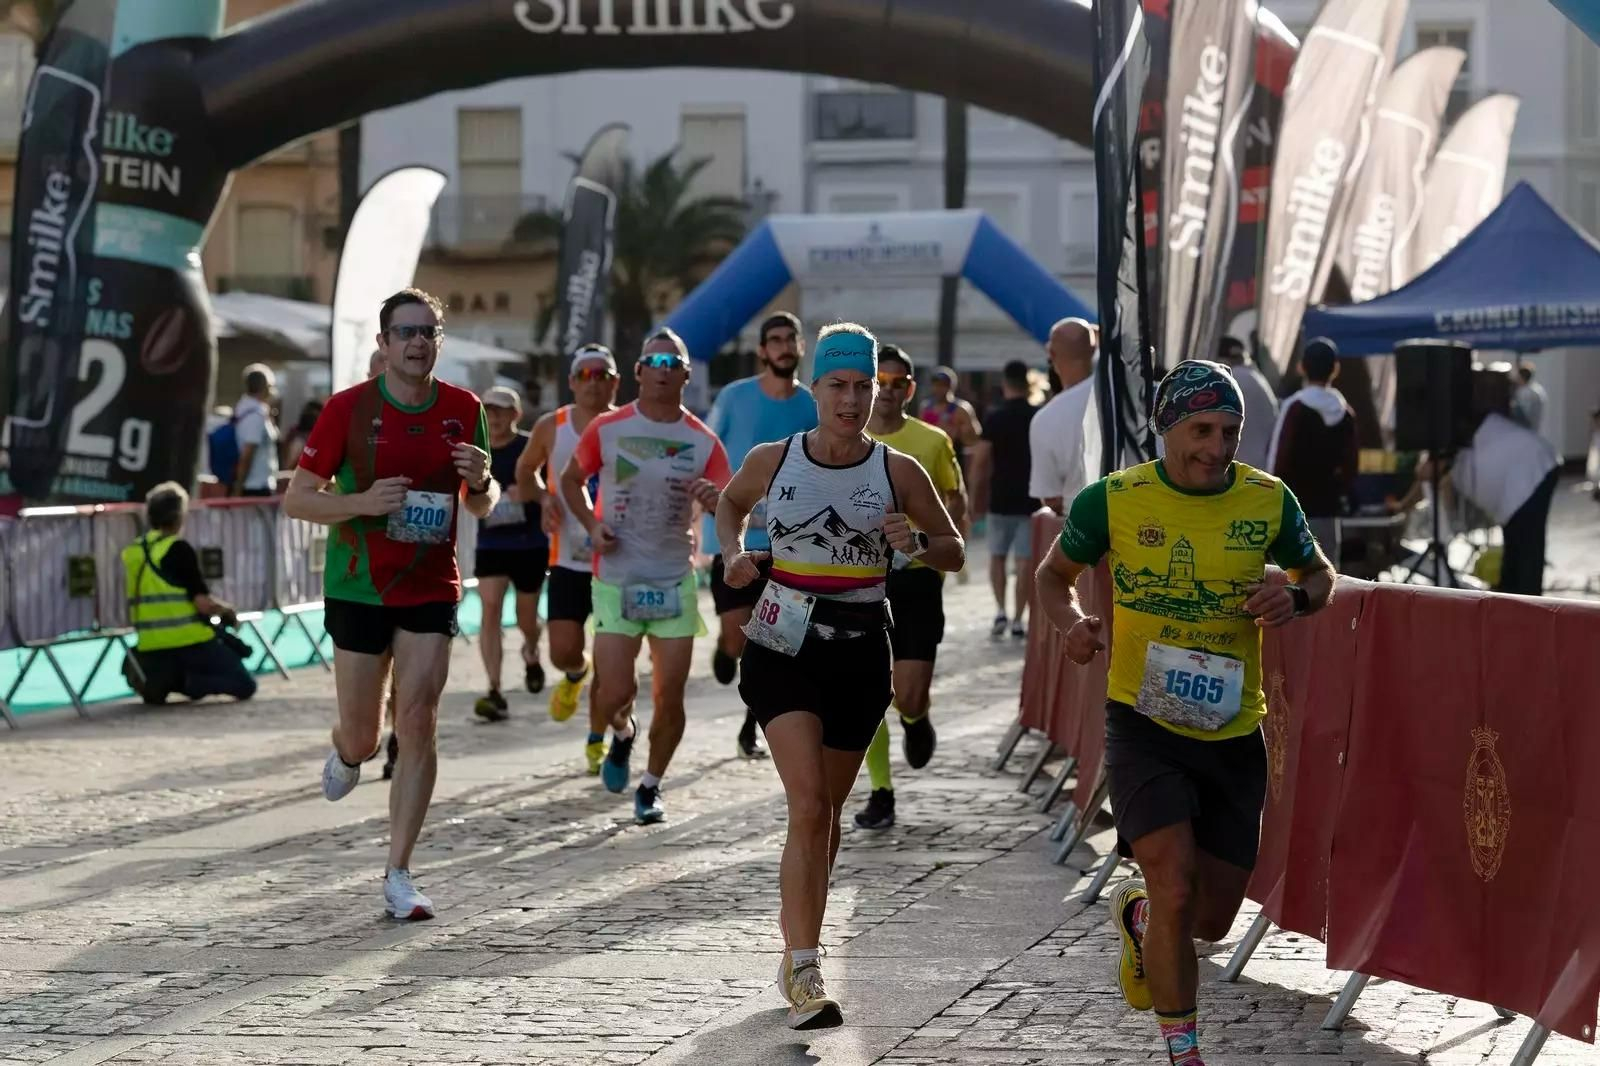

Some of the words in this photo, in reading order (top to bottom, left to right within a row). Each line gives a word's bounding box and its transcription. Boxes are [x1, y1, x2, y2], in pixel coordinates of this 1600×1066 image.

[1170, 44, 1228, 259] Smilke
[101, 154, 181, 197] TEIN
[1270, 137, 1346, 300] Smilke
[19, 171, 71, 328] Smilke
[86, 308, 134, 339] NAS
[405, 505, 446, 528] 1200
[636, 591, 665, 606] 283
[759, 598, 780, 626] 68
[1164, 669, 1225, 705] 1565
